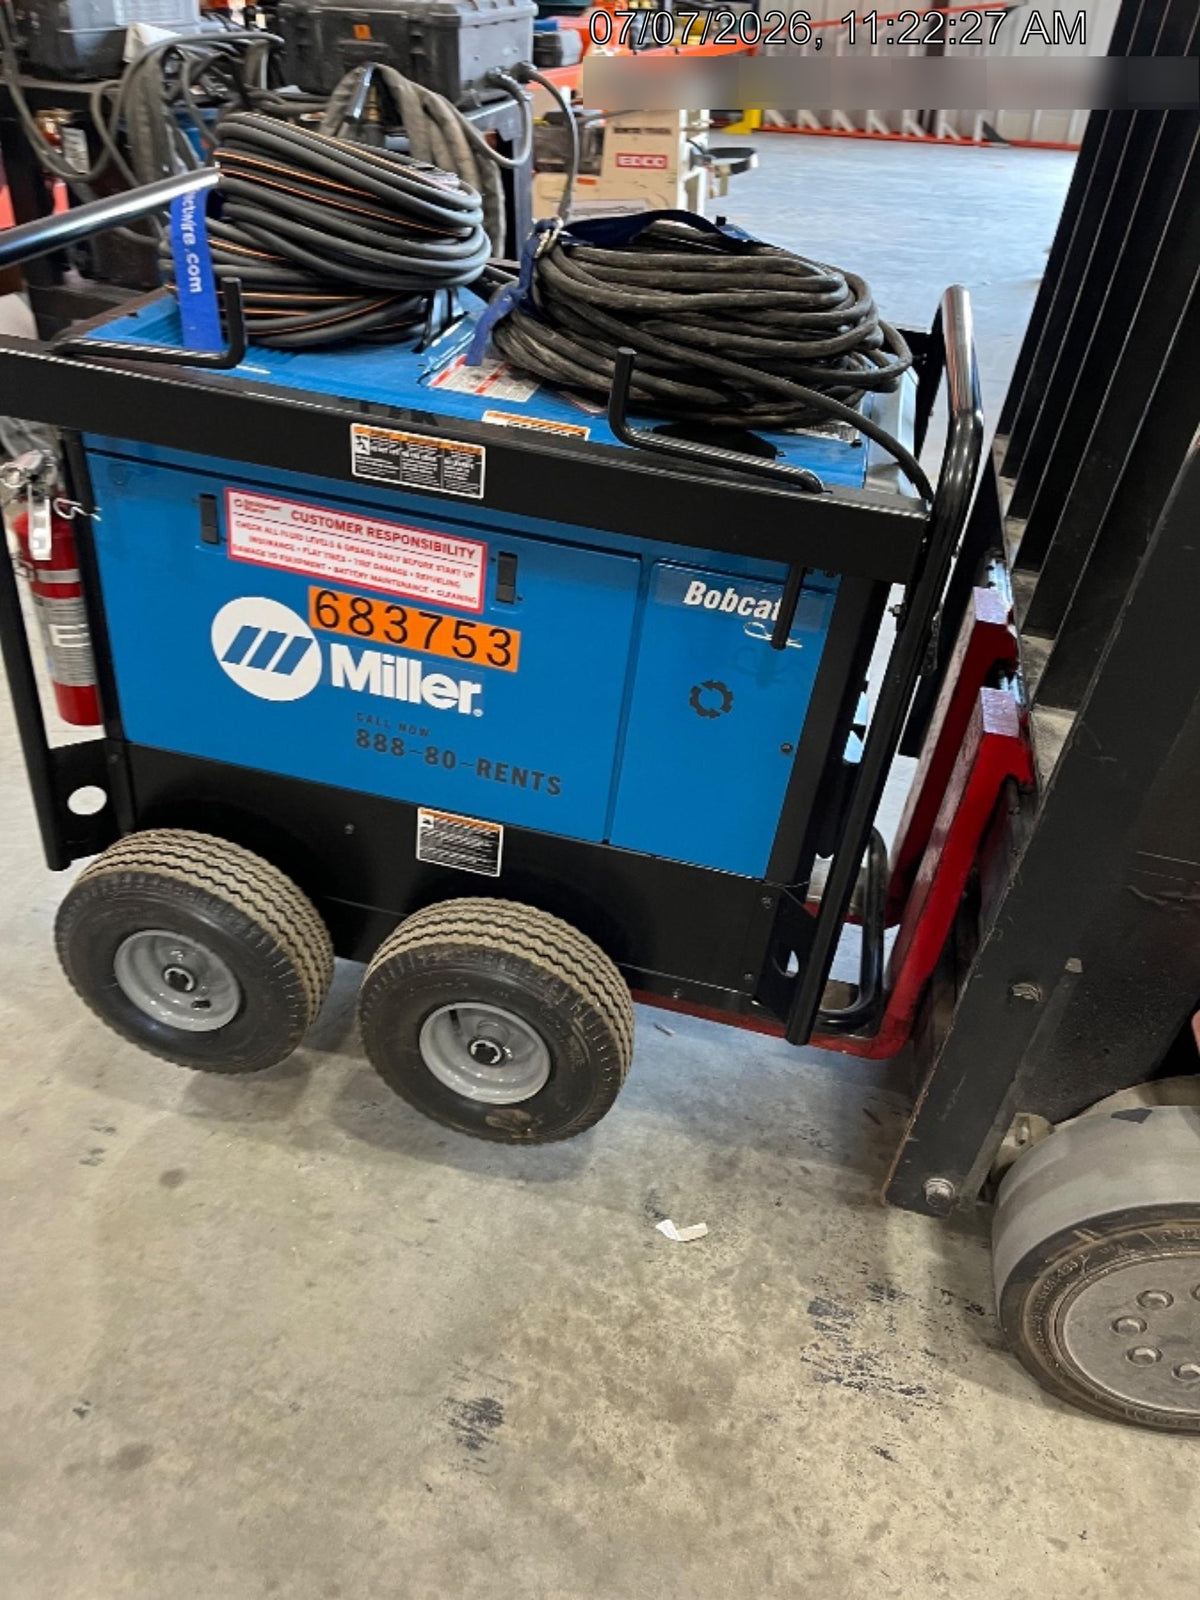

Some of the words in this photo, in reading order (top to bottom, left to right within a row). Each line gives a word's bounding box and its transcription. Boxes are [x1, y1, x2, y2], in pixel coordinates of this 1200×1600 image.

[264, 527, 279, 537] ALL
[377, 551, 401, 563] DAILY
[402, 556, 433, 570] BEFORE
[436, 565, 461, 575] START
[463, 570, 476, 579] UP
[291, 510, 363, 534] CUSTOMER
[366, 527, 476, 559] RESPONSIBILITY
[683, 580, 783, 621] Bobcat
[315, 590, 512, 668] 683753
[330, 643, 483, 715] Miller
[356, 712, 391, 730] CALL
[398, 722, 431, 738] NOW
[355, 728, 562, 796] 888-80-RENTS
